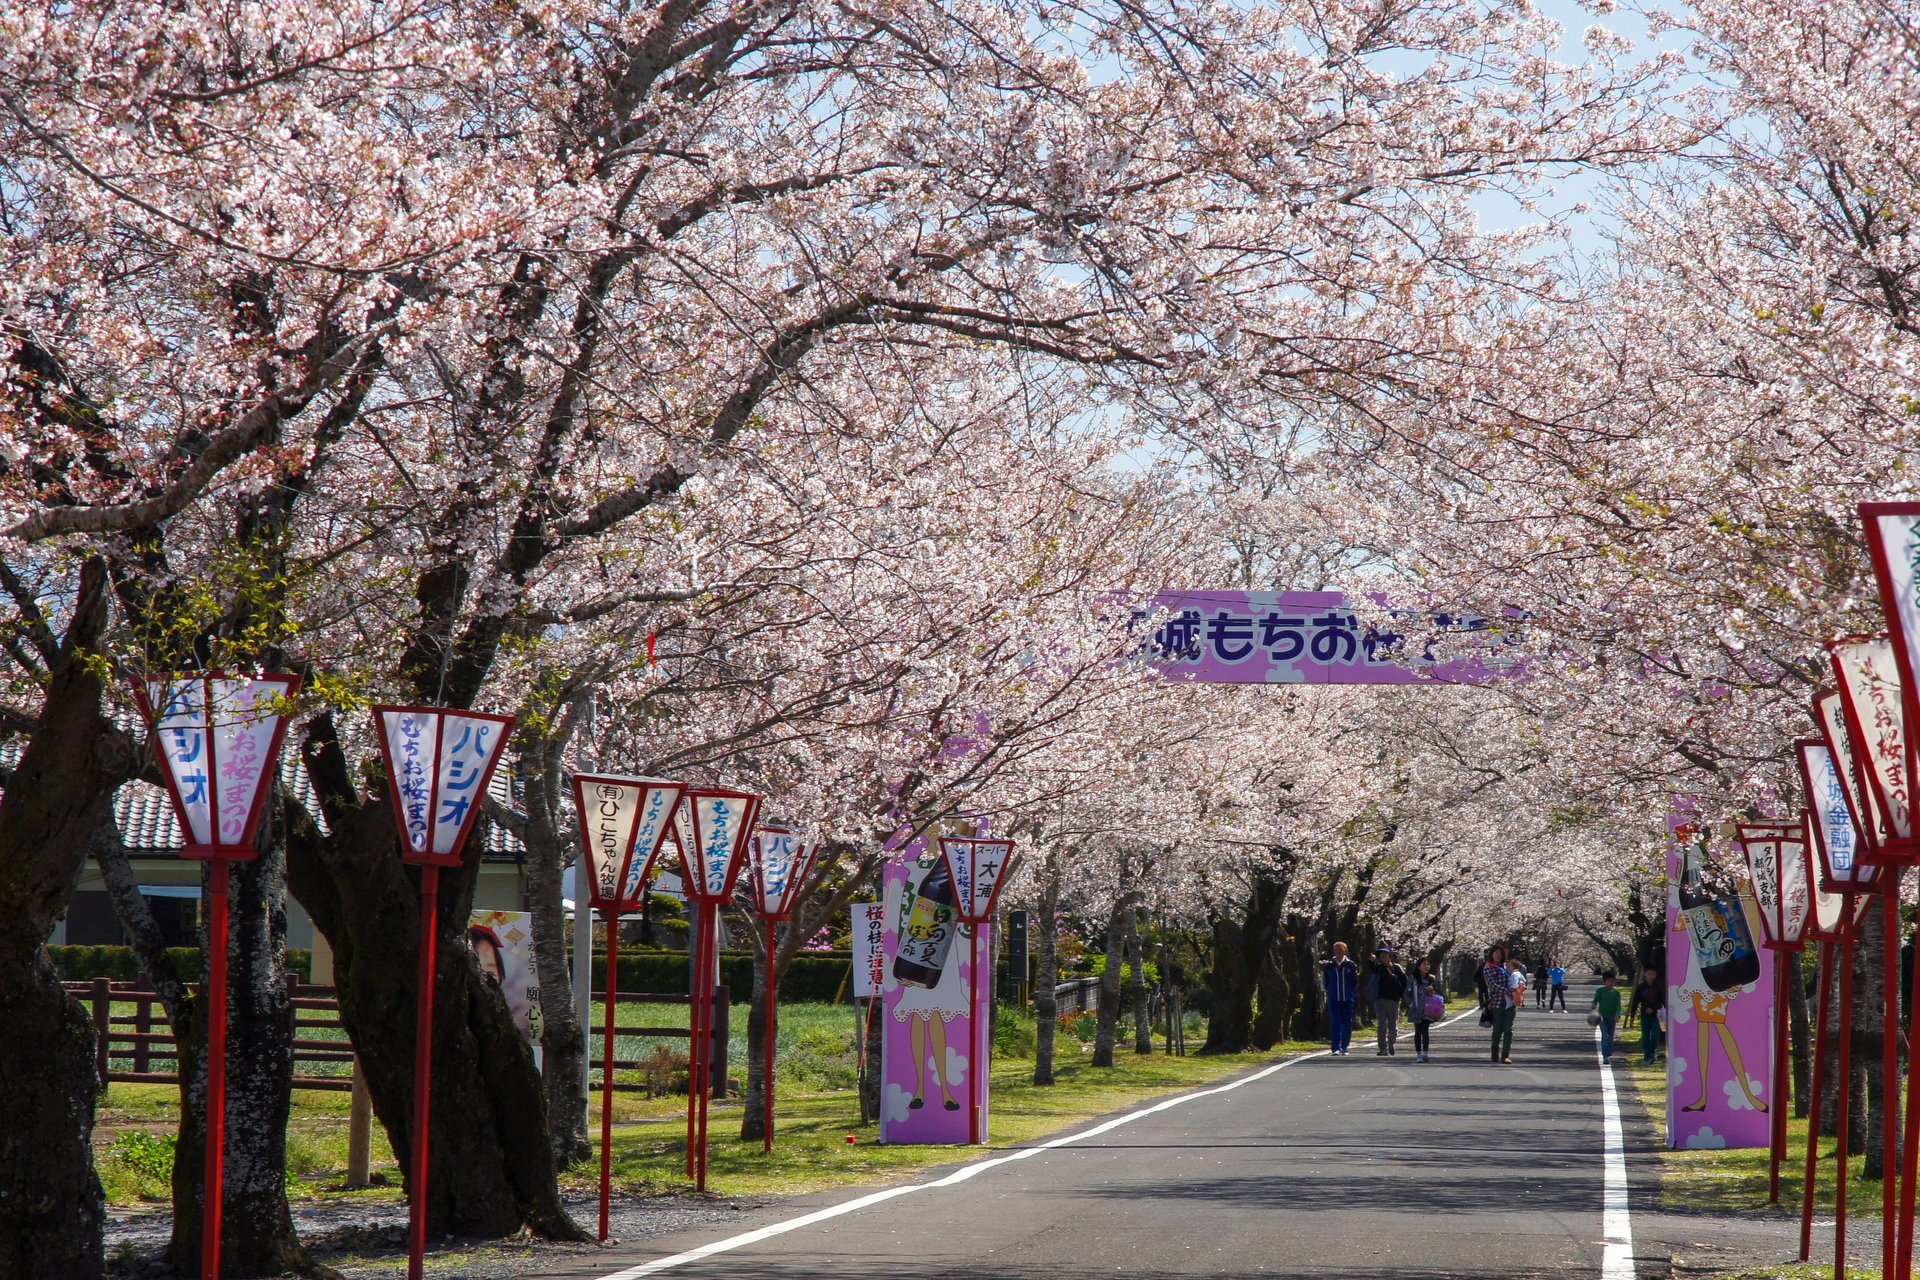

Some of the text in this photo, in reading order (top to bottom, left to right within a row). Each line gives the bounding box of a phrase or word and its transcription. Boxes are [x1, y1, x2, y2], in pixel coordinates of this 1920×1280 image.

[401, 717, 430, 848] もちお桜まつり
[438, 725, 489, 826] パシオ
[596, 784, 624, 899] (有)ひこちゃん牧場
[626, 790, 663, 894] もちお桜まつり
[706, 801, 731, 892] もちお桜まつり
[766, 836, 792, 897] パシオ
[975, 861, 998, 898] 大浦
[1755, 857, 1773, 909] 都城支部
[865, 906, 883, 994] 桜の枝に注意!
[918, 908, 952, 968] 日向夏
[525, 986, 541, 1039] 願心寺
